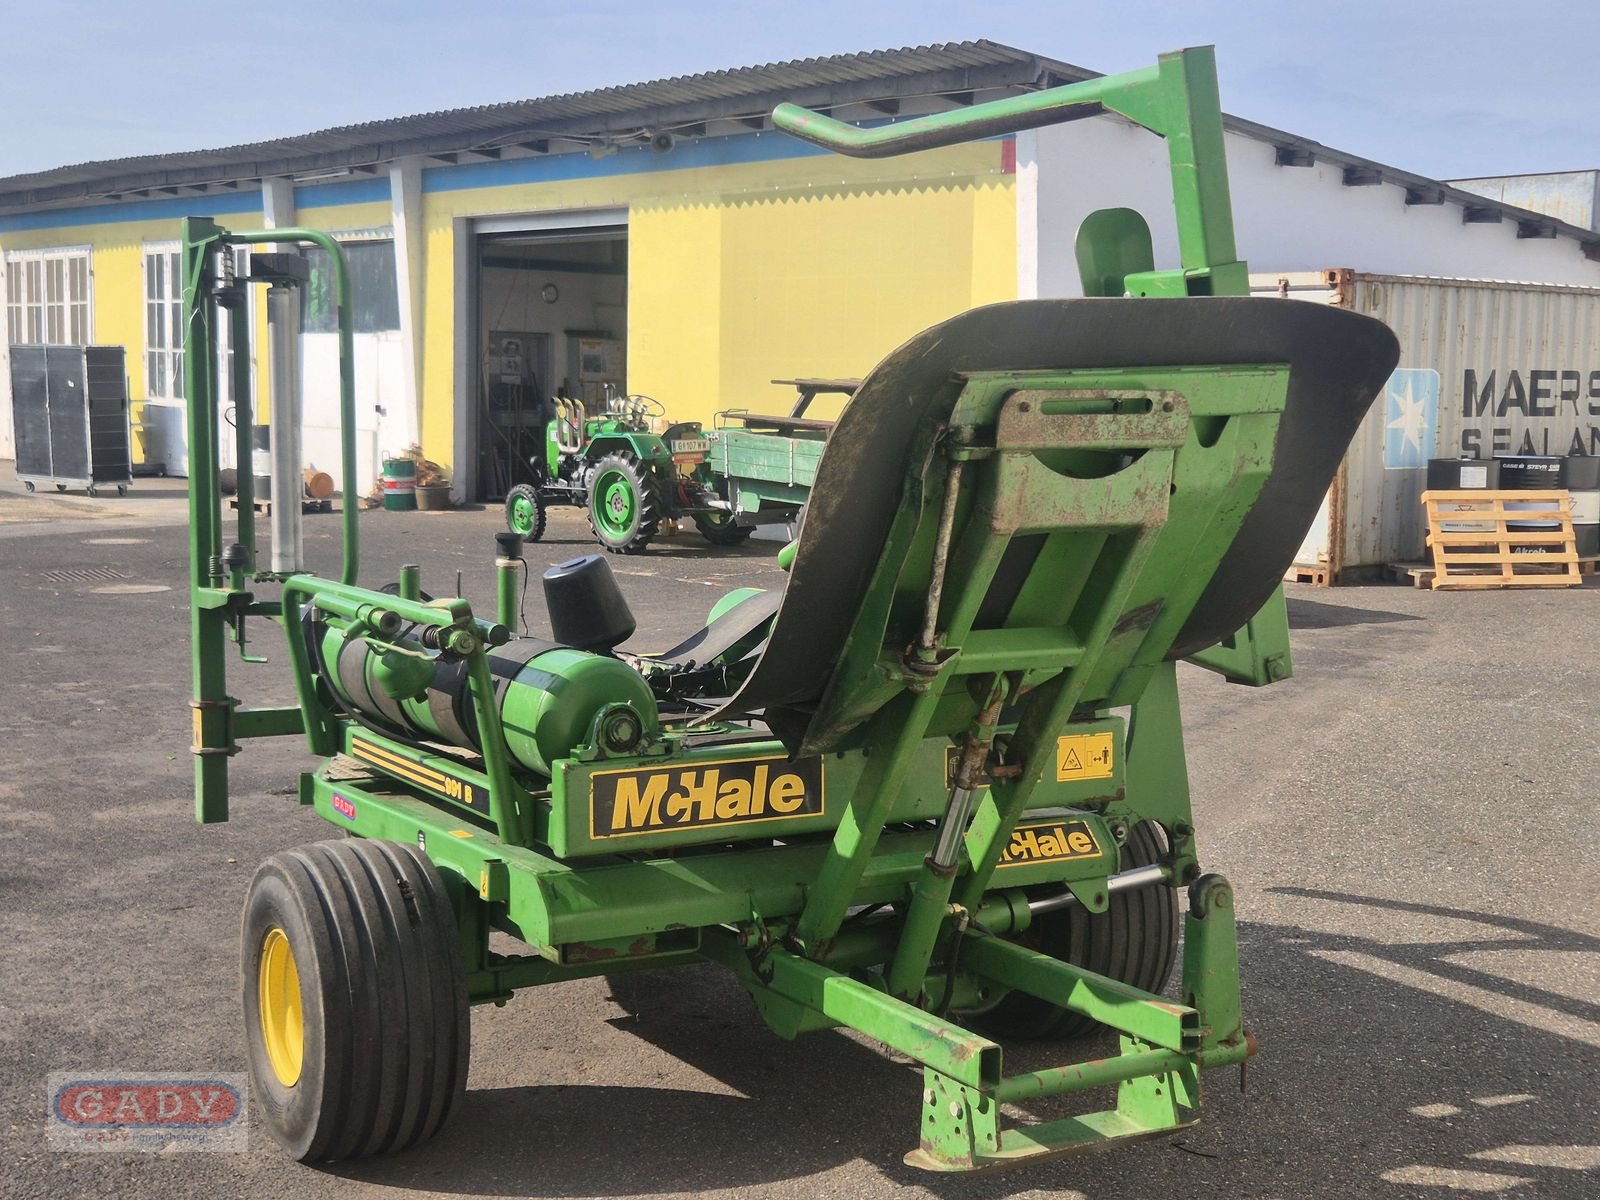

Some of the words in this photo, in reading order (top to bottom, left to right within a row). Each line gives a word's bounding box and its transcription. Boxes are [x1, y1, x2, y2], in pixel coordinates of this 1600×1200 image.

[334, 796, 354, 818] GADY
[464, 785, 473, 804] B
[610, 765, 805, 830] McHale
[999, 827, 1092, 861] cHale
